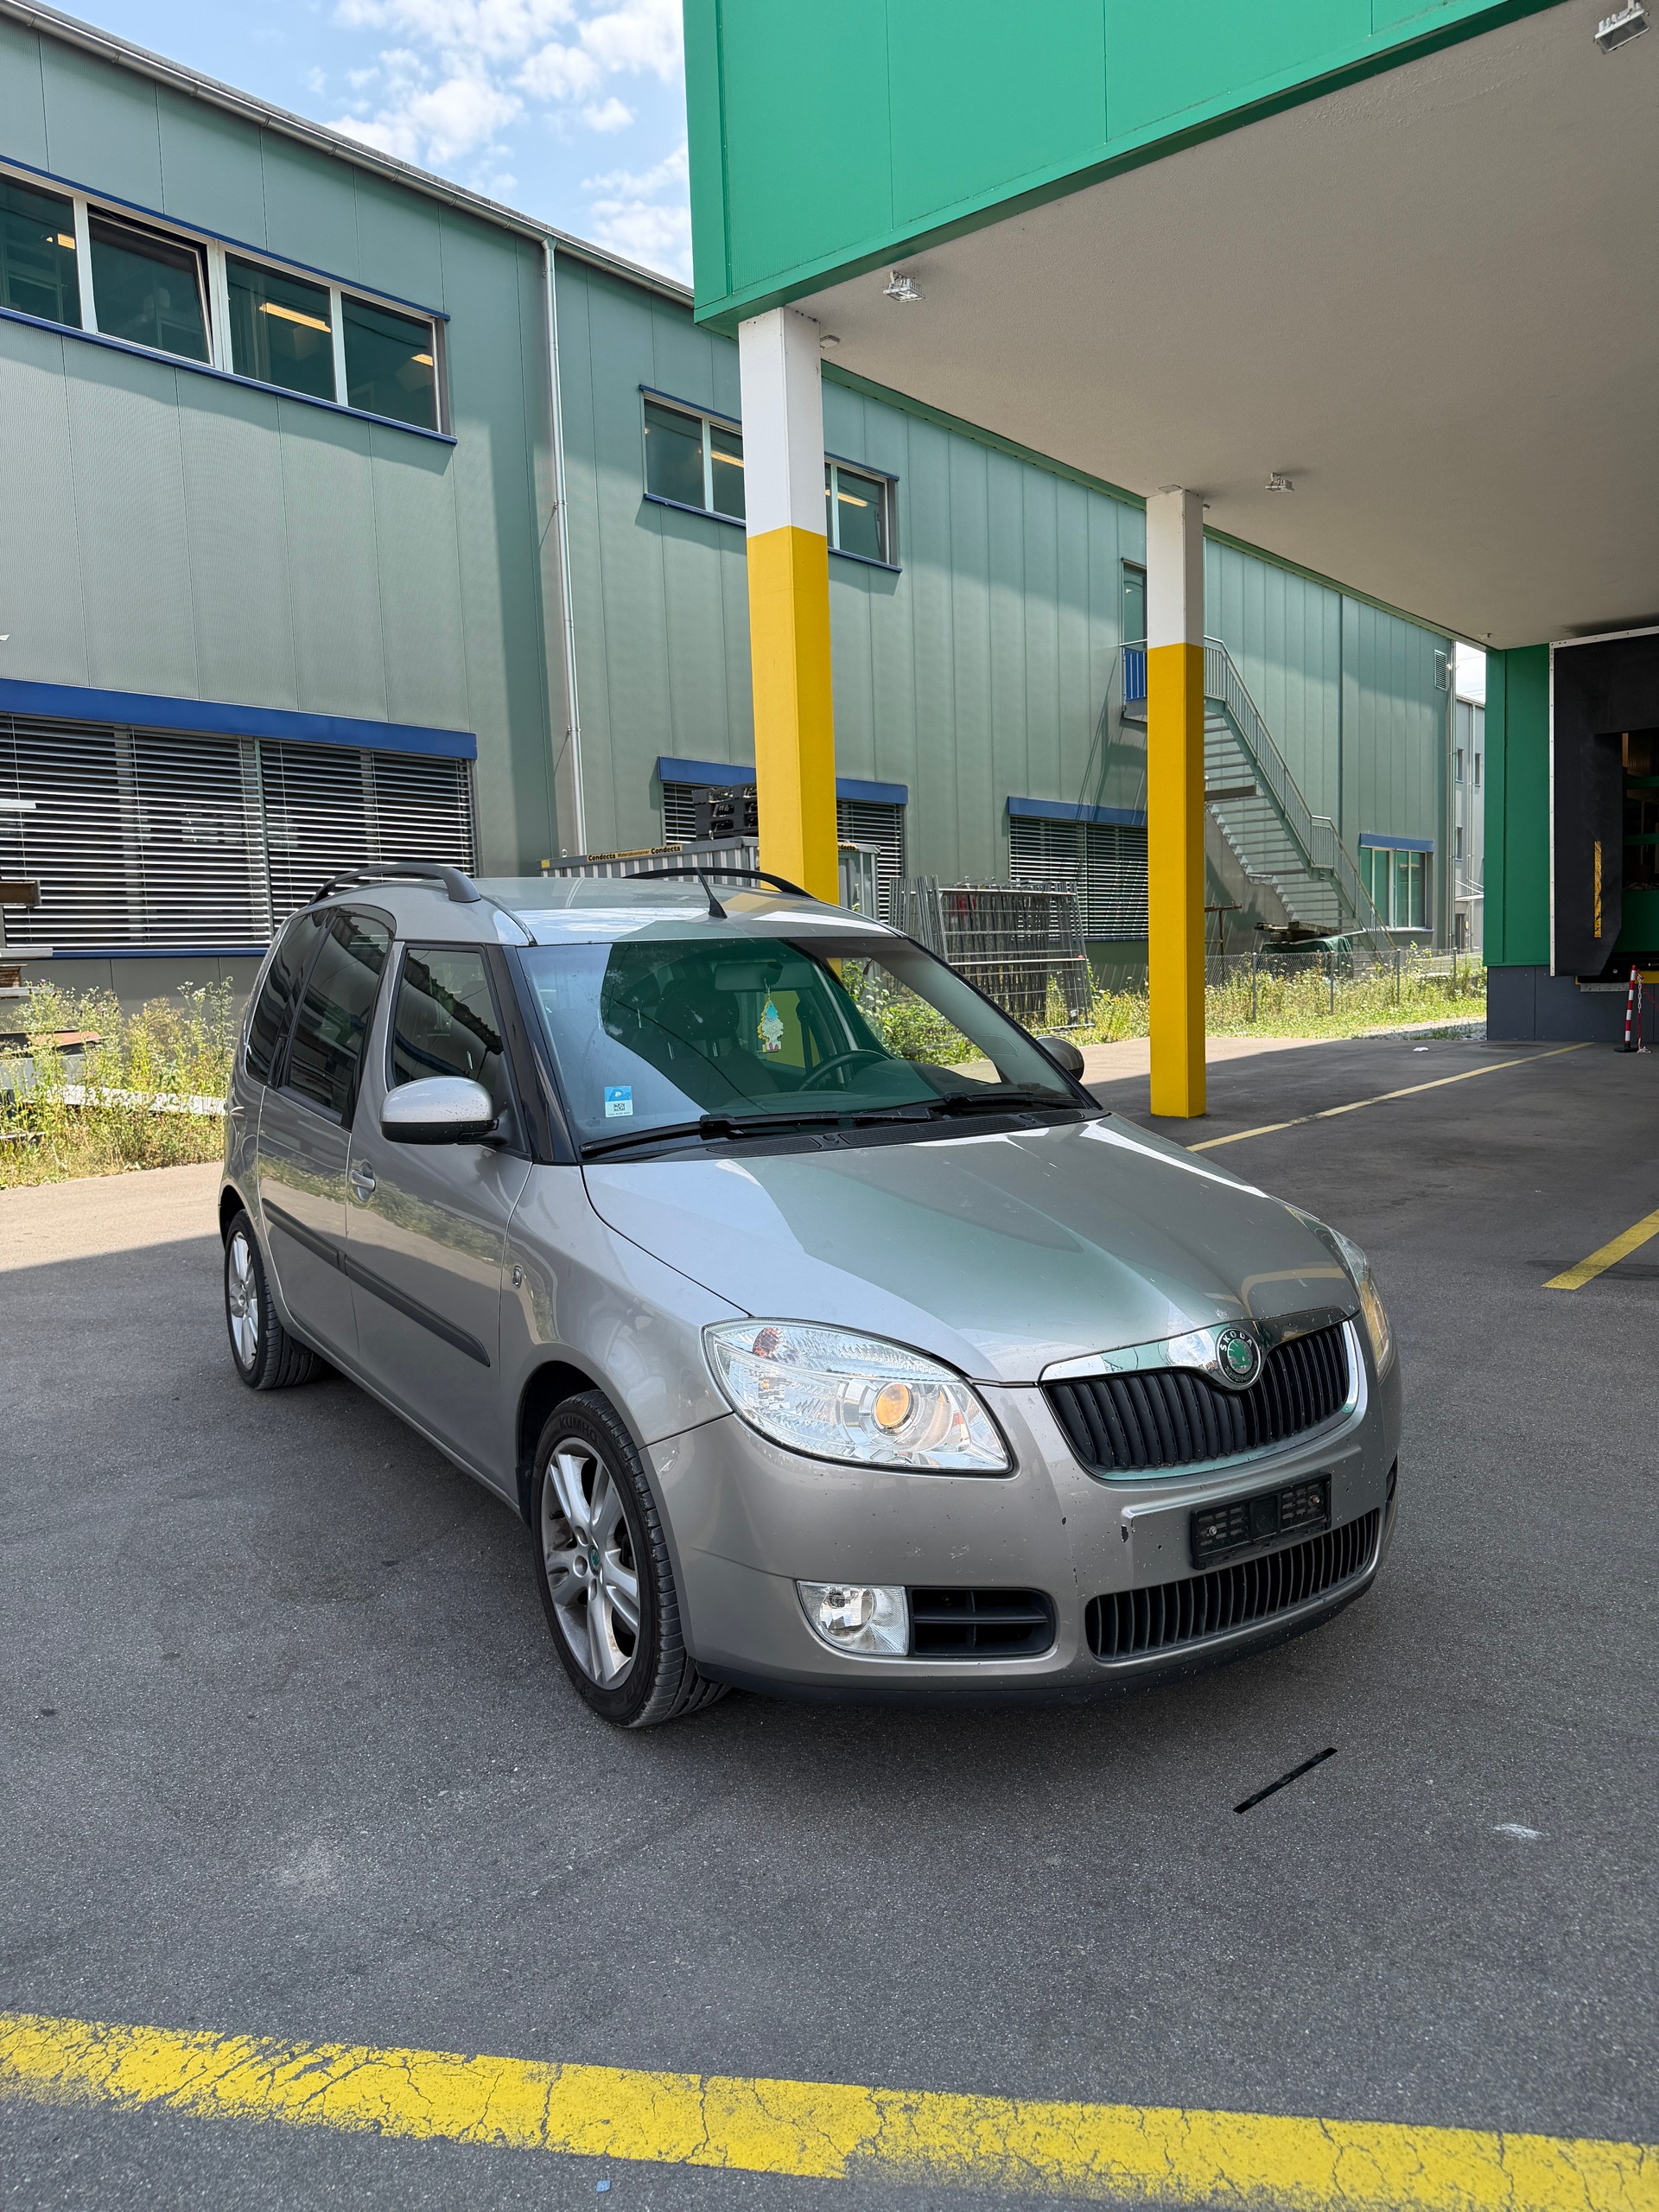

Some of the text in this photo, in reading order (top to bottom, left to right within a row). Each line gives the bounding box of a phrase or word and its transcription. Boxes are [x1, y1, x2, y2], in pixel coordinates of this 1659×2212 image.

[588, 853, 616, 861] Condecta
[651, 846, 681, 855] Condecta
[559, 1417, 599, 1445] KUMHO
